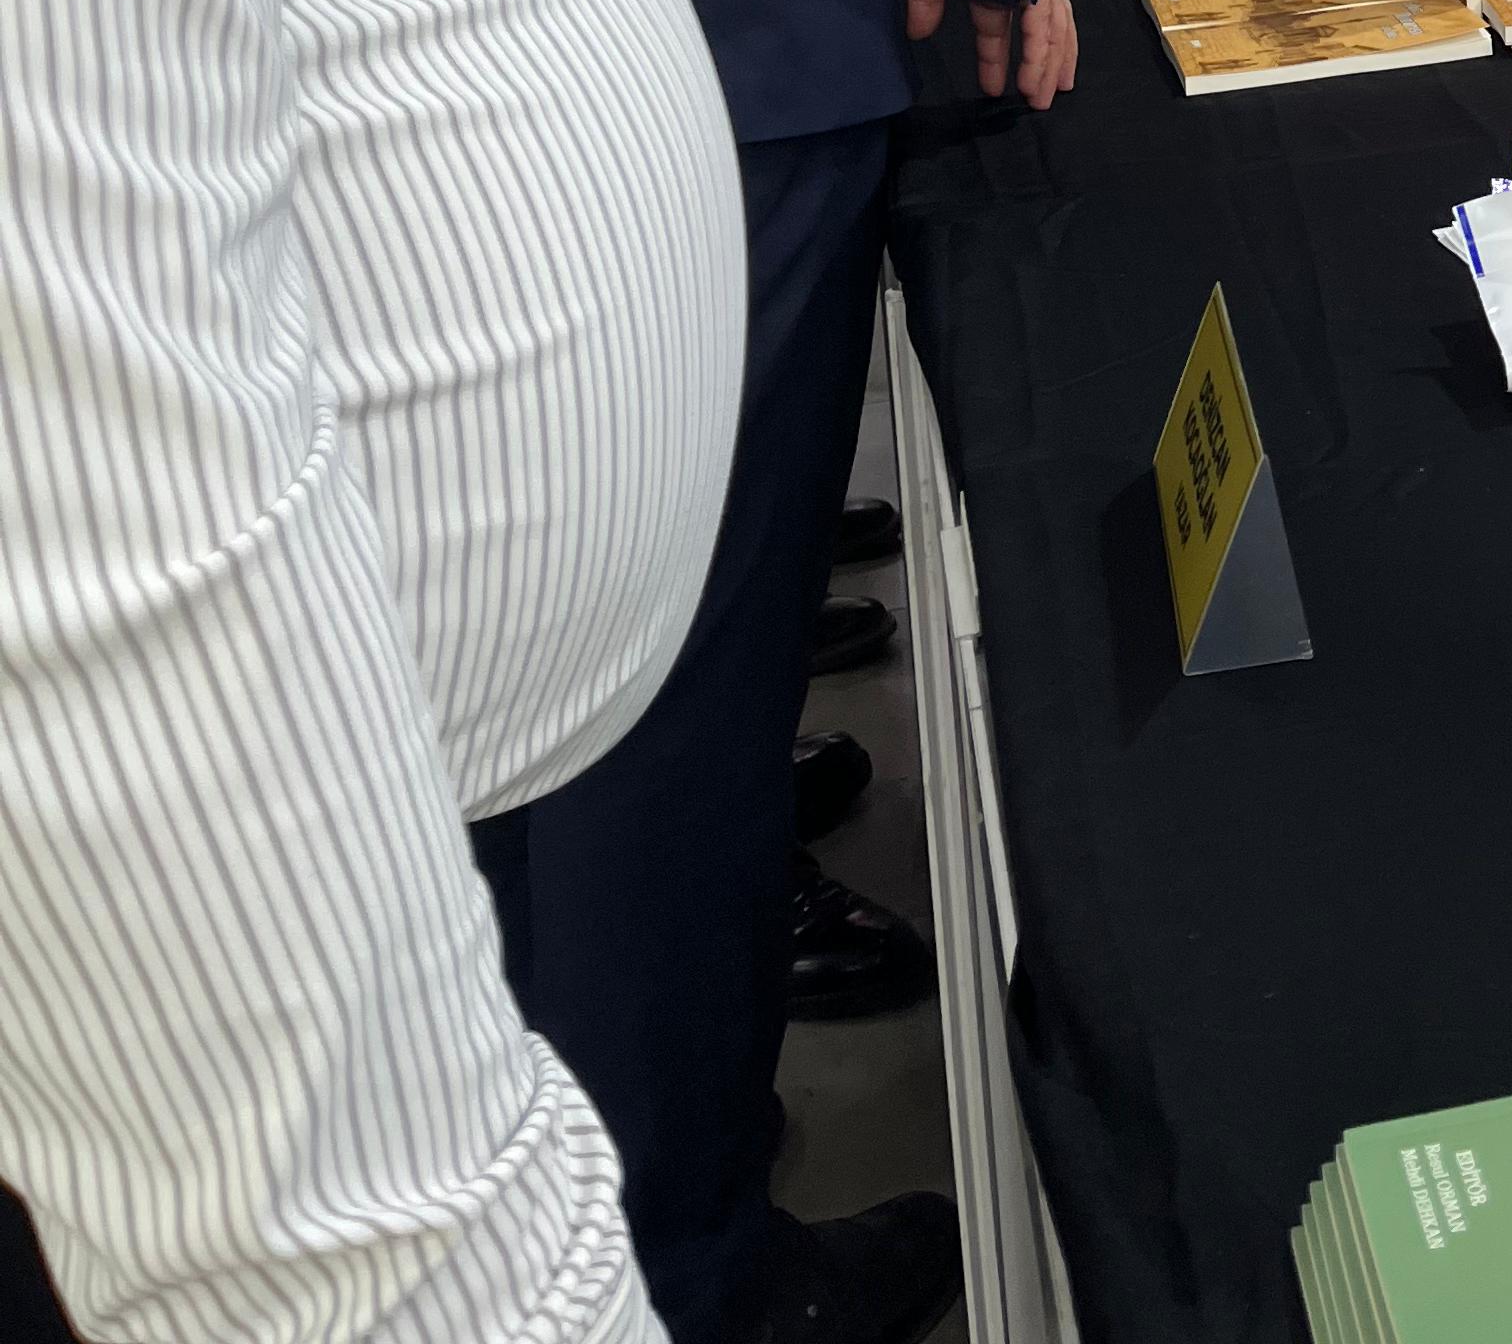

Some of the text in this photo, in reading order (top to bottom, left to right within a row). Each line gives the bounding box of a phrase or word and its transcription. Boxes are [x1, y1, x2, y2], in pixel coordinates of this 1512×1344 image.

[1199, 368, 1231, 488] DENİZCAN
[1400, 1148, 1446, 1249] Mehdi DEHKAN
[1423, 1143, 1467, 1233] Resul ORMAN
[1456, 1149, 1488, 1207] EDİTÖR
